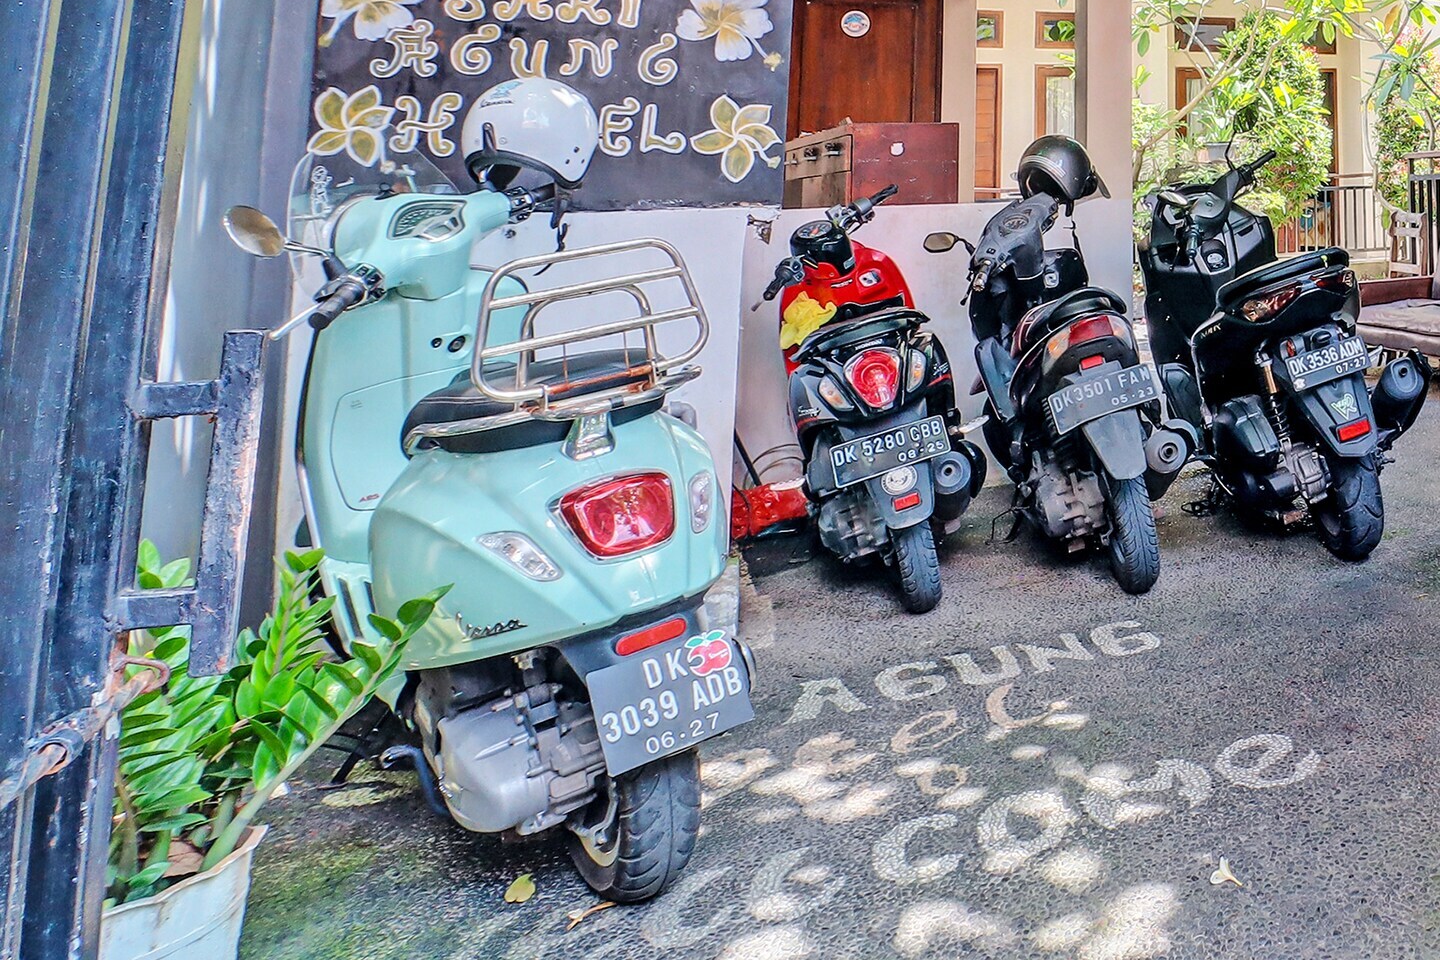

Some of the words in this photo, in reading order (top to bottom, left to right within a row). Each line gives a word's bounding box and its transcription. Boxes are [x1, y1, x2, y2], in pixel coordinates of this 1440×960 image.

[370, 18, 680, 86] AGUNG
[389, 92, 687, 159] HEL
[1288, 356, 1308, 376] DK
[1306, 346, 1339, 369] 3536
[1339, 338, 1364, 359] ADM
[1052, 390, 1074, 413] DK
[1073, 378, 1112, 401] 3501
[1117, 366, 1151, 388] FAN
[833, 445, 857, 467] DK
[861, 431, 906, 456] 5280
[909, 420, 942, 442] GBB
[455, 611, 529, 643] Vespa
[642, 648, 688, 689] DK
[783, 619, 1162, 726] AGUNG
[601, 690, 680, 743] 3039
[692, 666, 743, 711] ADB
